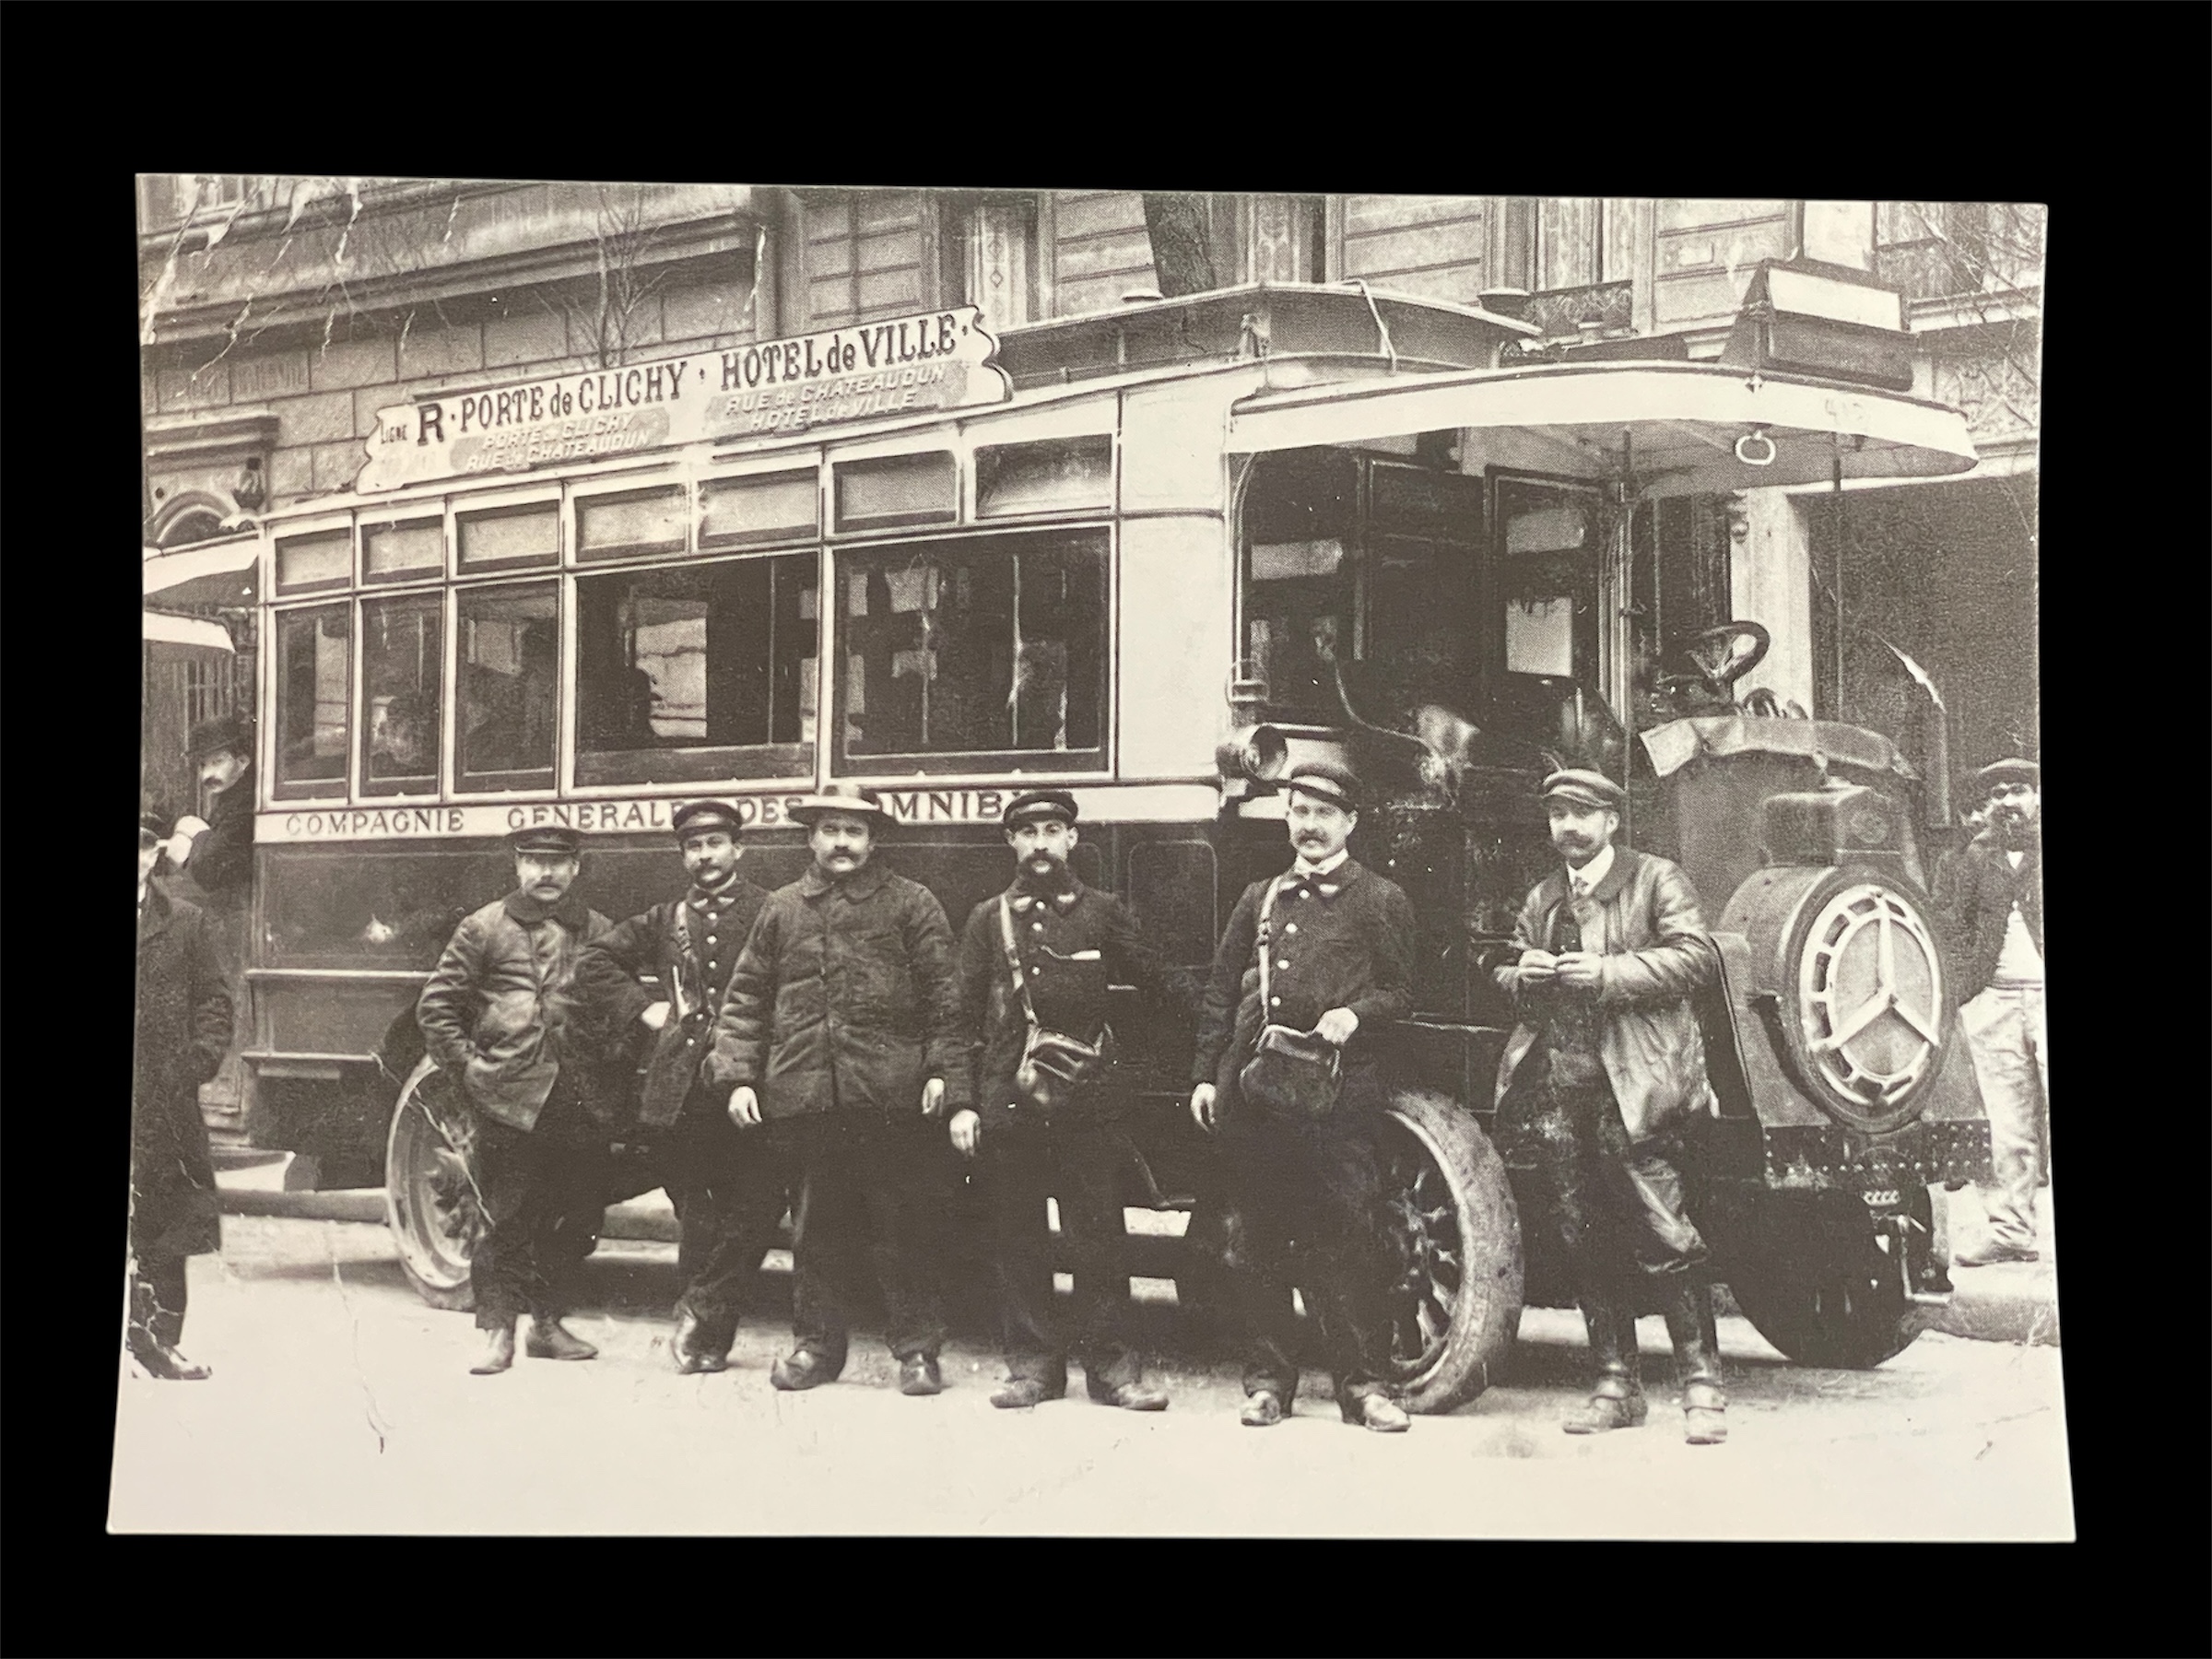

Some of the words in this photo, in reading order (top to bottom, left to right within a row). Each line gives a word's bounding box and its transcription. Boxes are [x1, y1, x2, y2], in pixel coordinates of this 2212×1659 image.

[418, 402, 445, 446] R
[460, 386, 544, 432] PORTE
[549, 382, 571, 418] de
[578, 360, 687, 411] CLICHY
[721, 337, 823, 392] HOTEL
[828, 334, 856, 373] de
[858, 313, 957, 369] VILLE
[724, 392, 772, 417] RUE
[851, 388, 919, 417] VILLE
[482, 429, 543, 451] PORTE
[561, 414, 633, 442] CLICHY
[287, 808, 465, 835] COMPAGNIE
